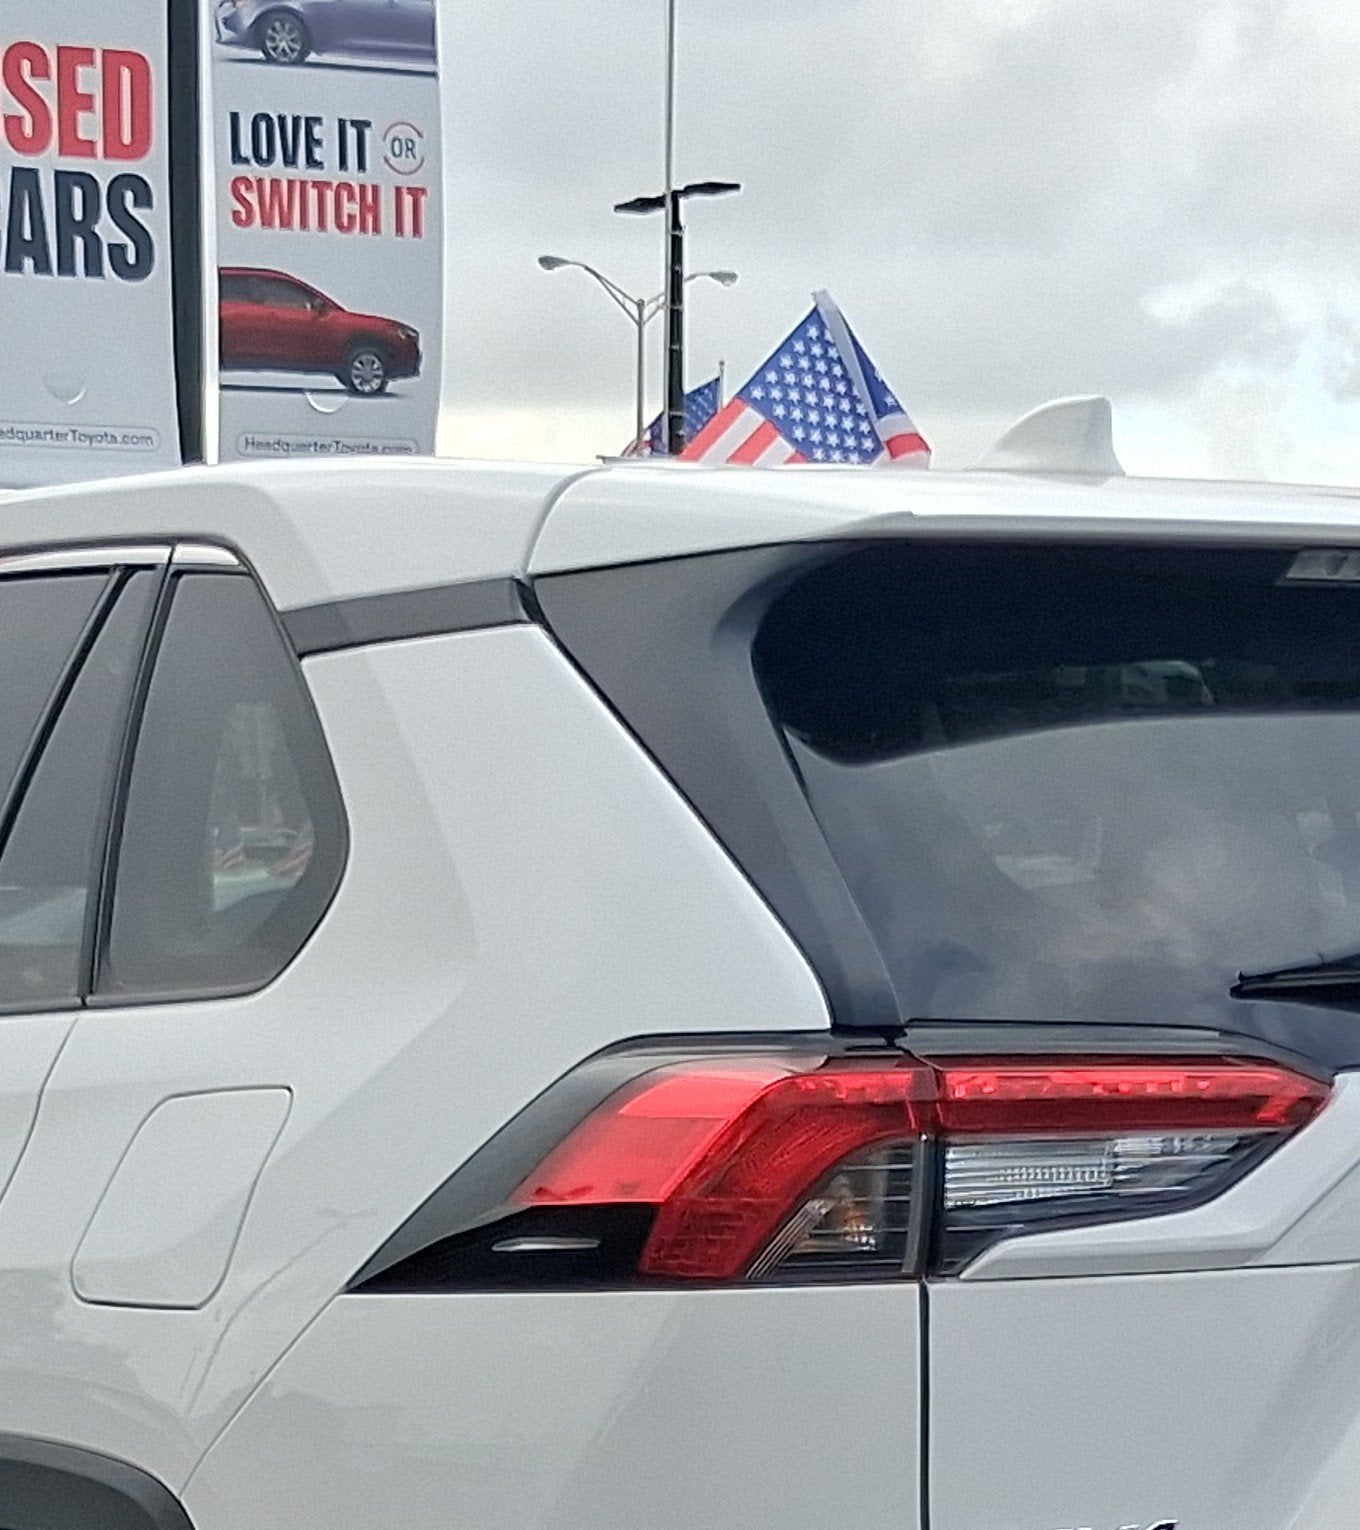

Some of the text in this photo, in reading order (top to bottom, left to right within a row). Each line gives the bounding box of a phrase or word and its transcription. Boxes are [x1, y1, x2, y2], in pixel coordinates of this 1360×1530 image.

[229, 111, 417, 173] LOVE IT OR
[230, 176, 427, 239] SWITCH IT
